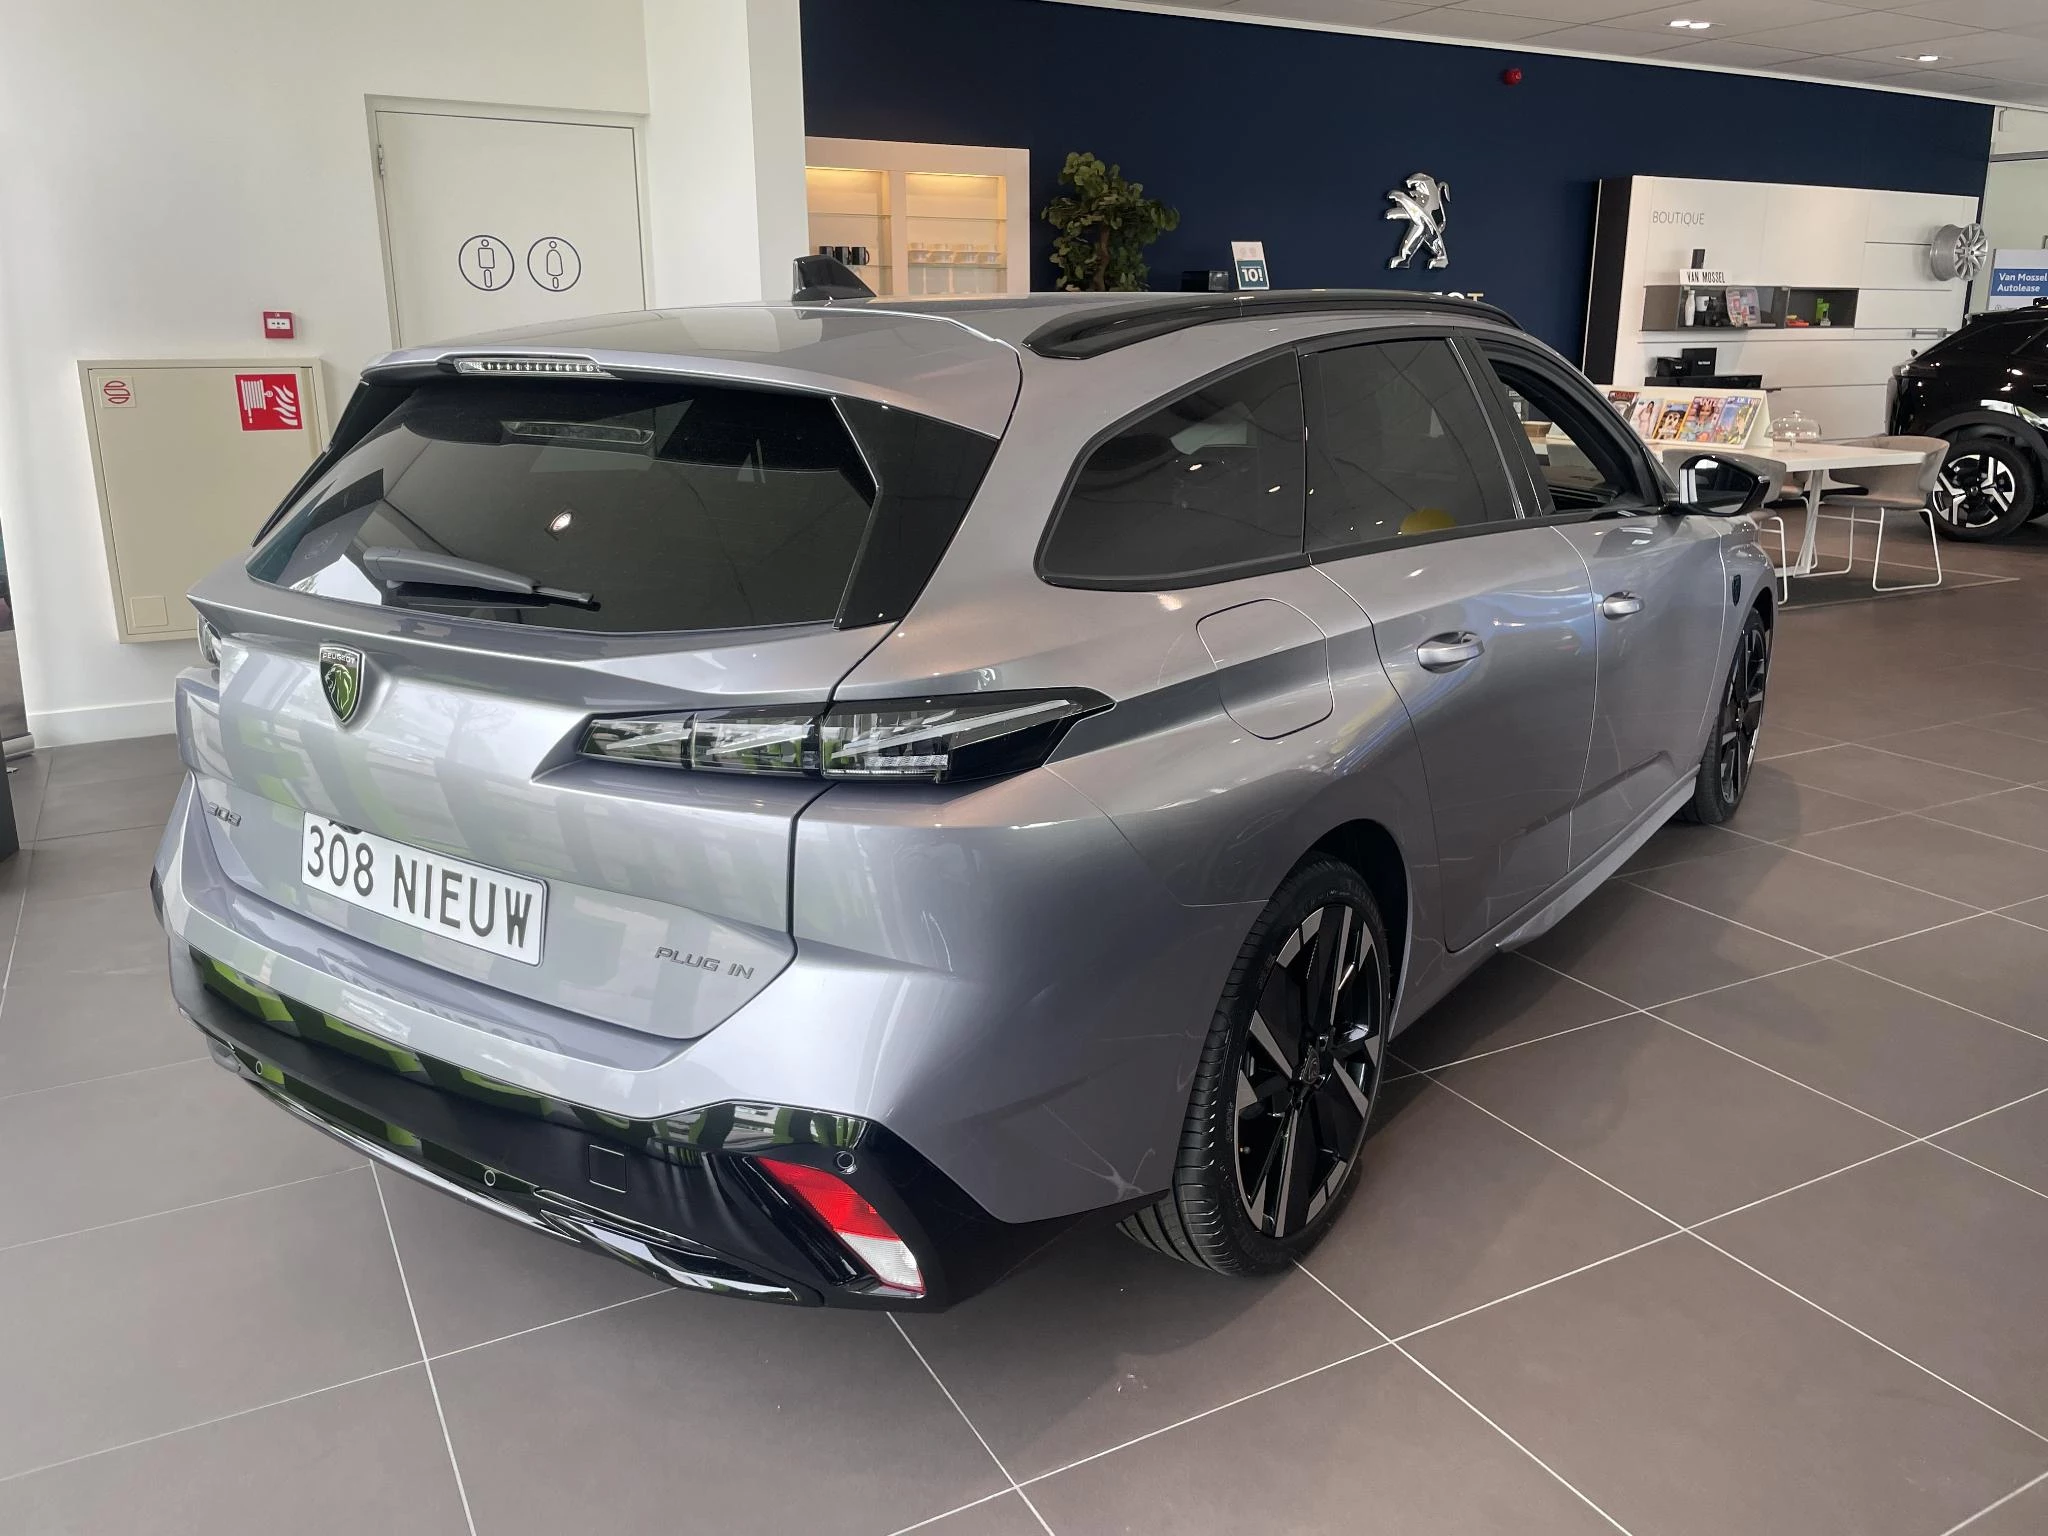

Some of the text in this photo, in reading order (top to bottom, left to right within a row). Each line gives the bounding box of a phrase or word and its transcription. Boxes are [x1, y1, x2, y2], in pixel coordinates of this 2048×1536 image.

[1652, 210, 1705, 227] BOUTIQUE
[1687, 271, 1726, 284] VAN MOSSEL
[1999, 272, 2048, 282] Van Mossel
[1997, 283, 2041, 292] Autolease
[307, 825, 533, 949] 308 NIEUW
[655, 946, 755, 980] PLUG IN
